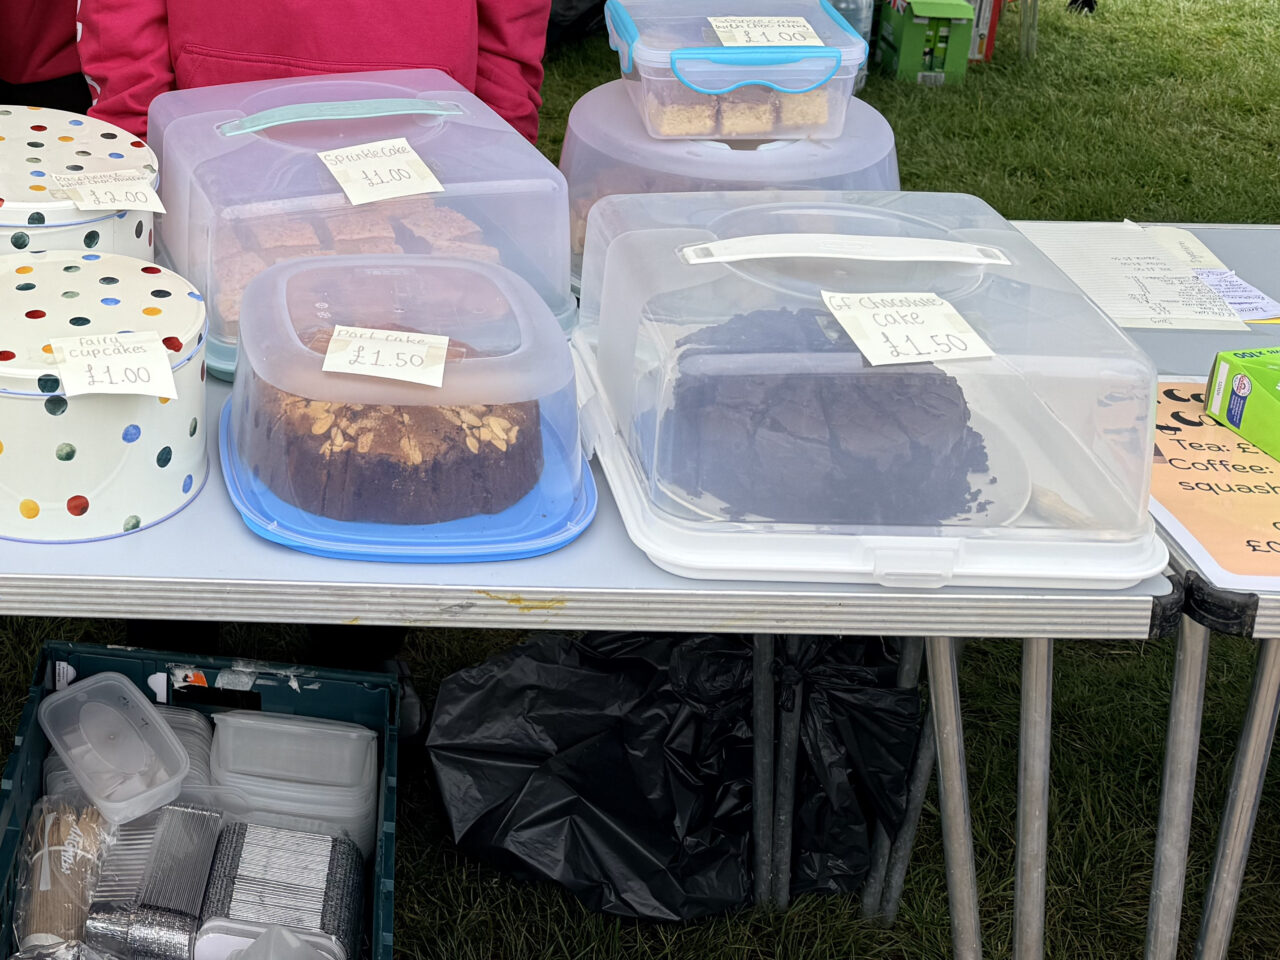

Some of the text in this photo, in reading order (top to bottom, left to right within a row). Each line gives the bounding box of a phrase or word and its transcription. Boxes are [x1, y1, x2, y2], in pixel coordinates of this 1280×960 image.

[324, 144, 410, 166] Sprinkle Cake
[362, 168, 411, 187] £1.00
[858, 296, 944, 310] Chocolate
[881, 331, 968, 357] £1.50
[348, 344, 424, 368] £1.50
[85, 364, 151, 386] £1.00
[1169, 438, 1230, 453] Tea:
[1169, 457, 1274, 475] Coffee:
